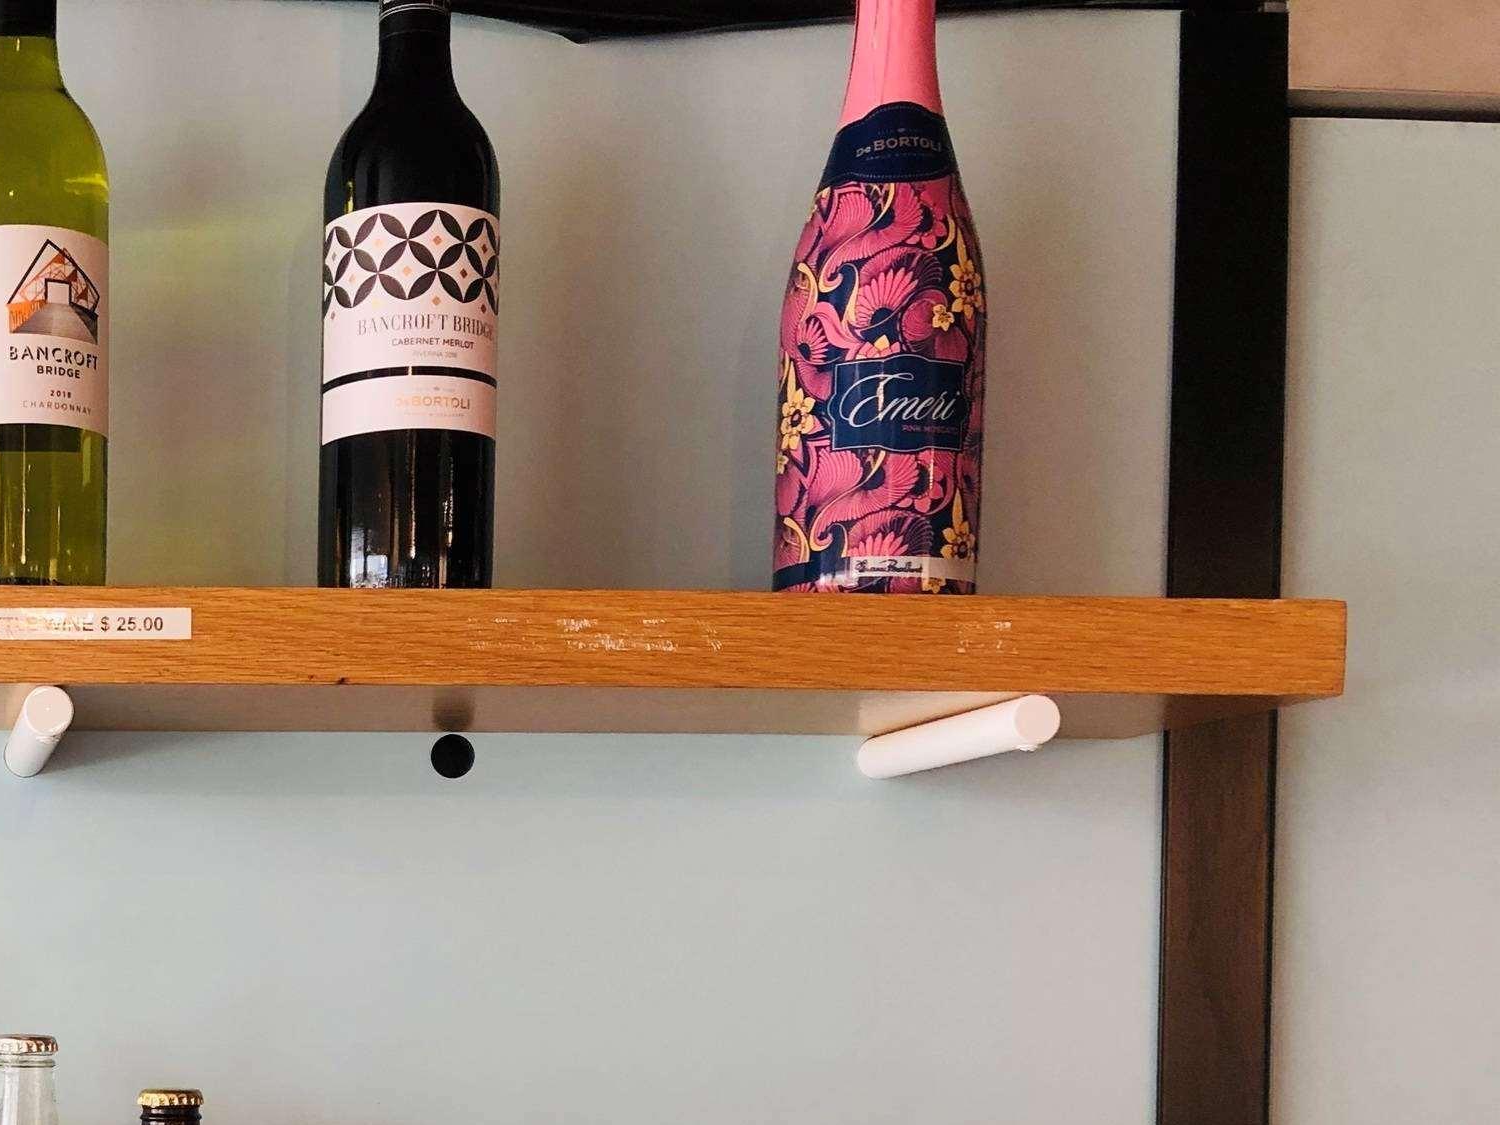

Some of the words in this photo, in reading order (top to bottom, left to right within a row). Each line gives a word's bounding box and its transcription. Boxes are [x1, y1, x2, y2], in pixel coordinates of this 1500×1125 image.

[357, 314, 449, 336] BANCROFT
[392, 337, 440, 347] CABERNET
[442, 338, 475, 350] MERLOT
[9, 345, 99, 372] BANCROFT
[36, 365, 81, 379] BRIDGE
[22, 401, 92, 416] CHARDONNAY
[100, 616, 110, 633] $
[117, 617, 163, 632] 25.00
